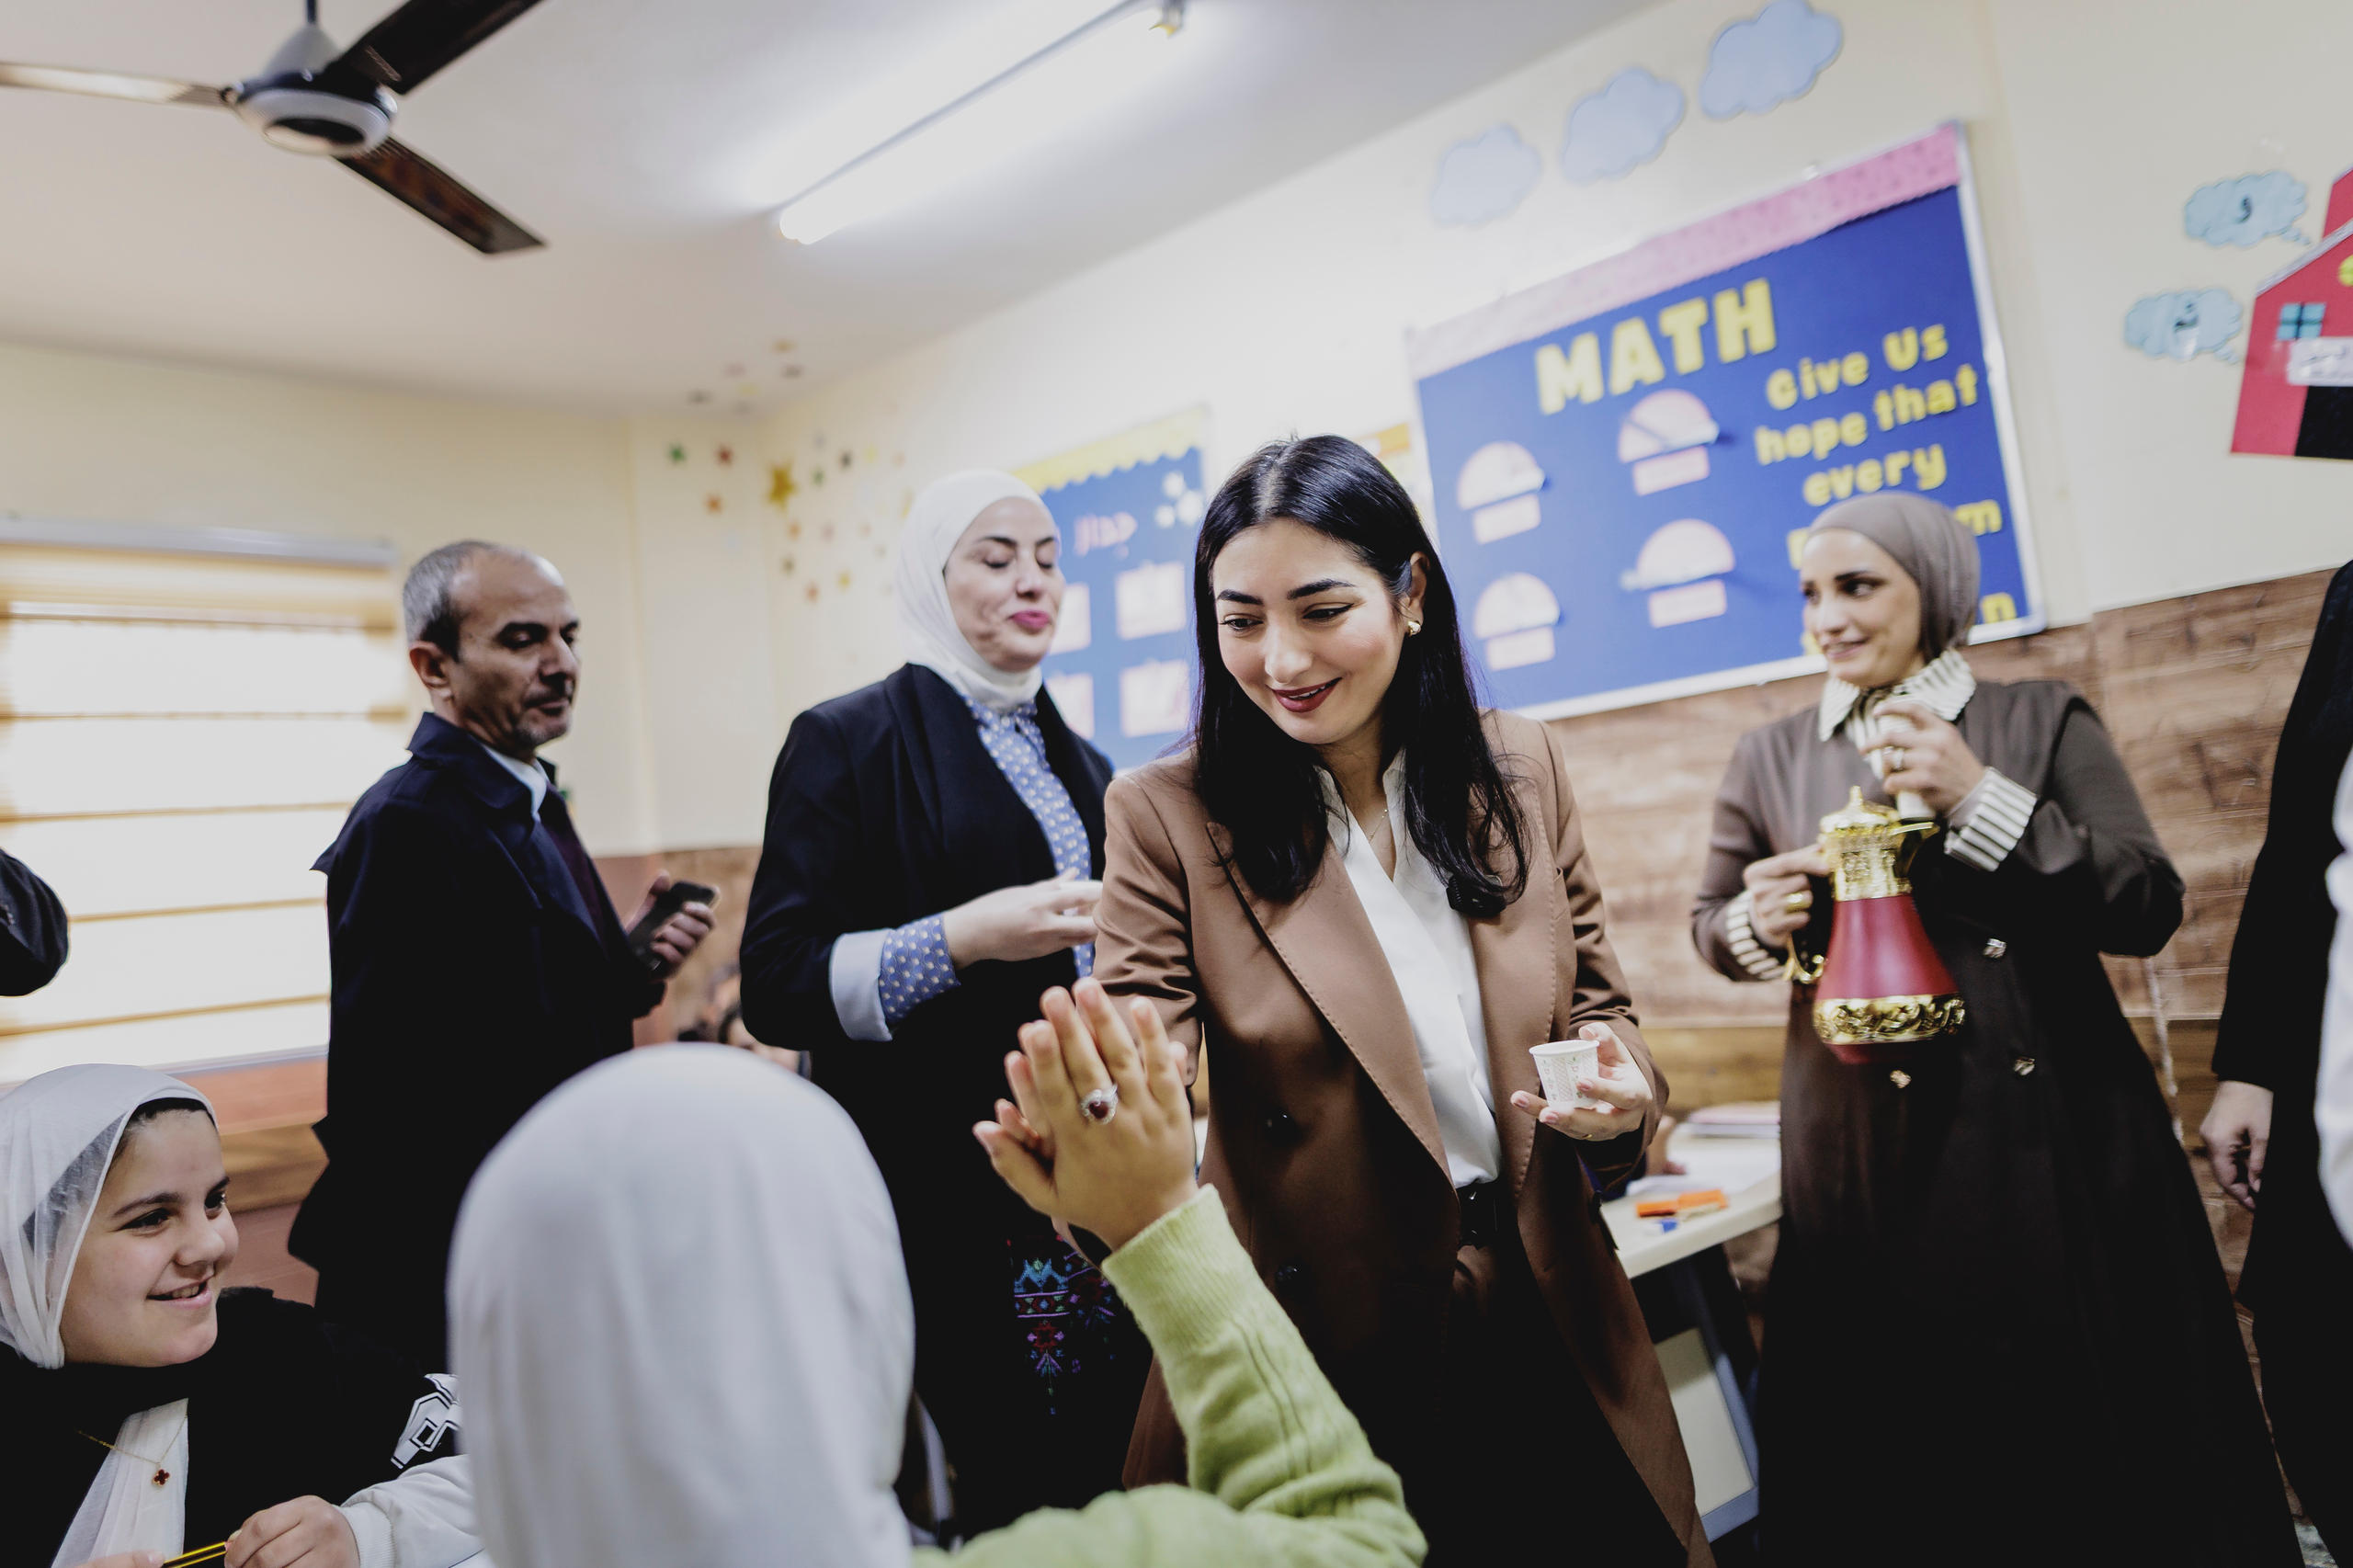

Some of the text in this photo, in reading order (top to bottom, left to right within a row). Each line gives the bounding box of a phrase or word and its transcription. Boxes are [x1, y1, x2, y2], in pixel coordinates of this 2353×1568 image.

[1534, 277, 1777, 415] MATH
[1766, 324, 1949, 411] Give Us
[1754, 363, 1978, 466] hope that
[1802, 443, 1948, 507] every
